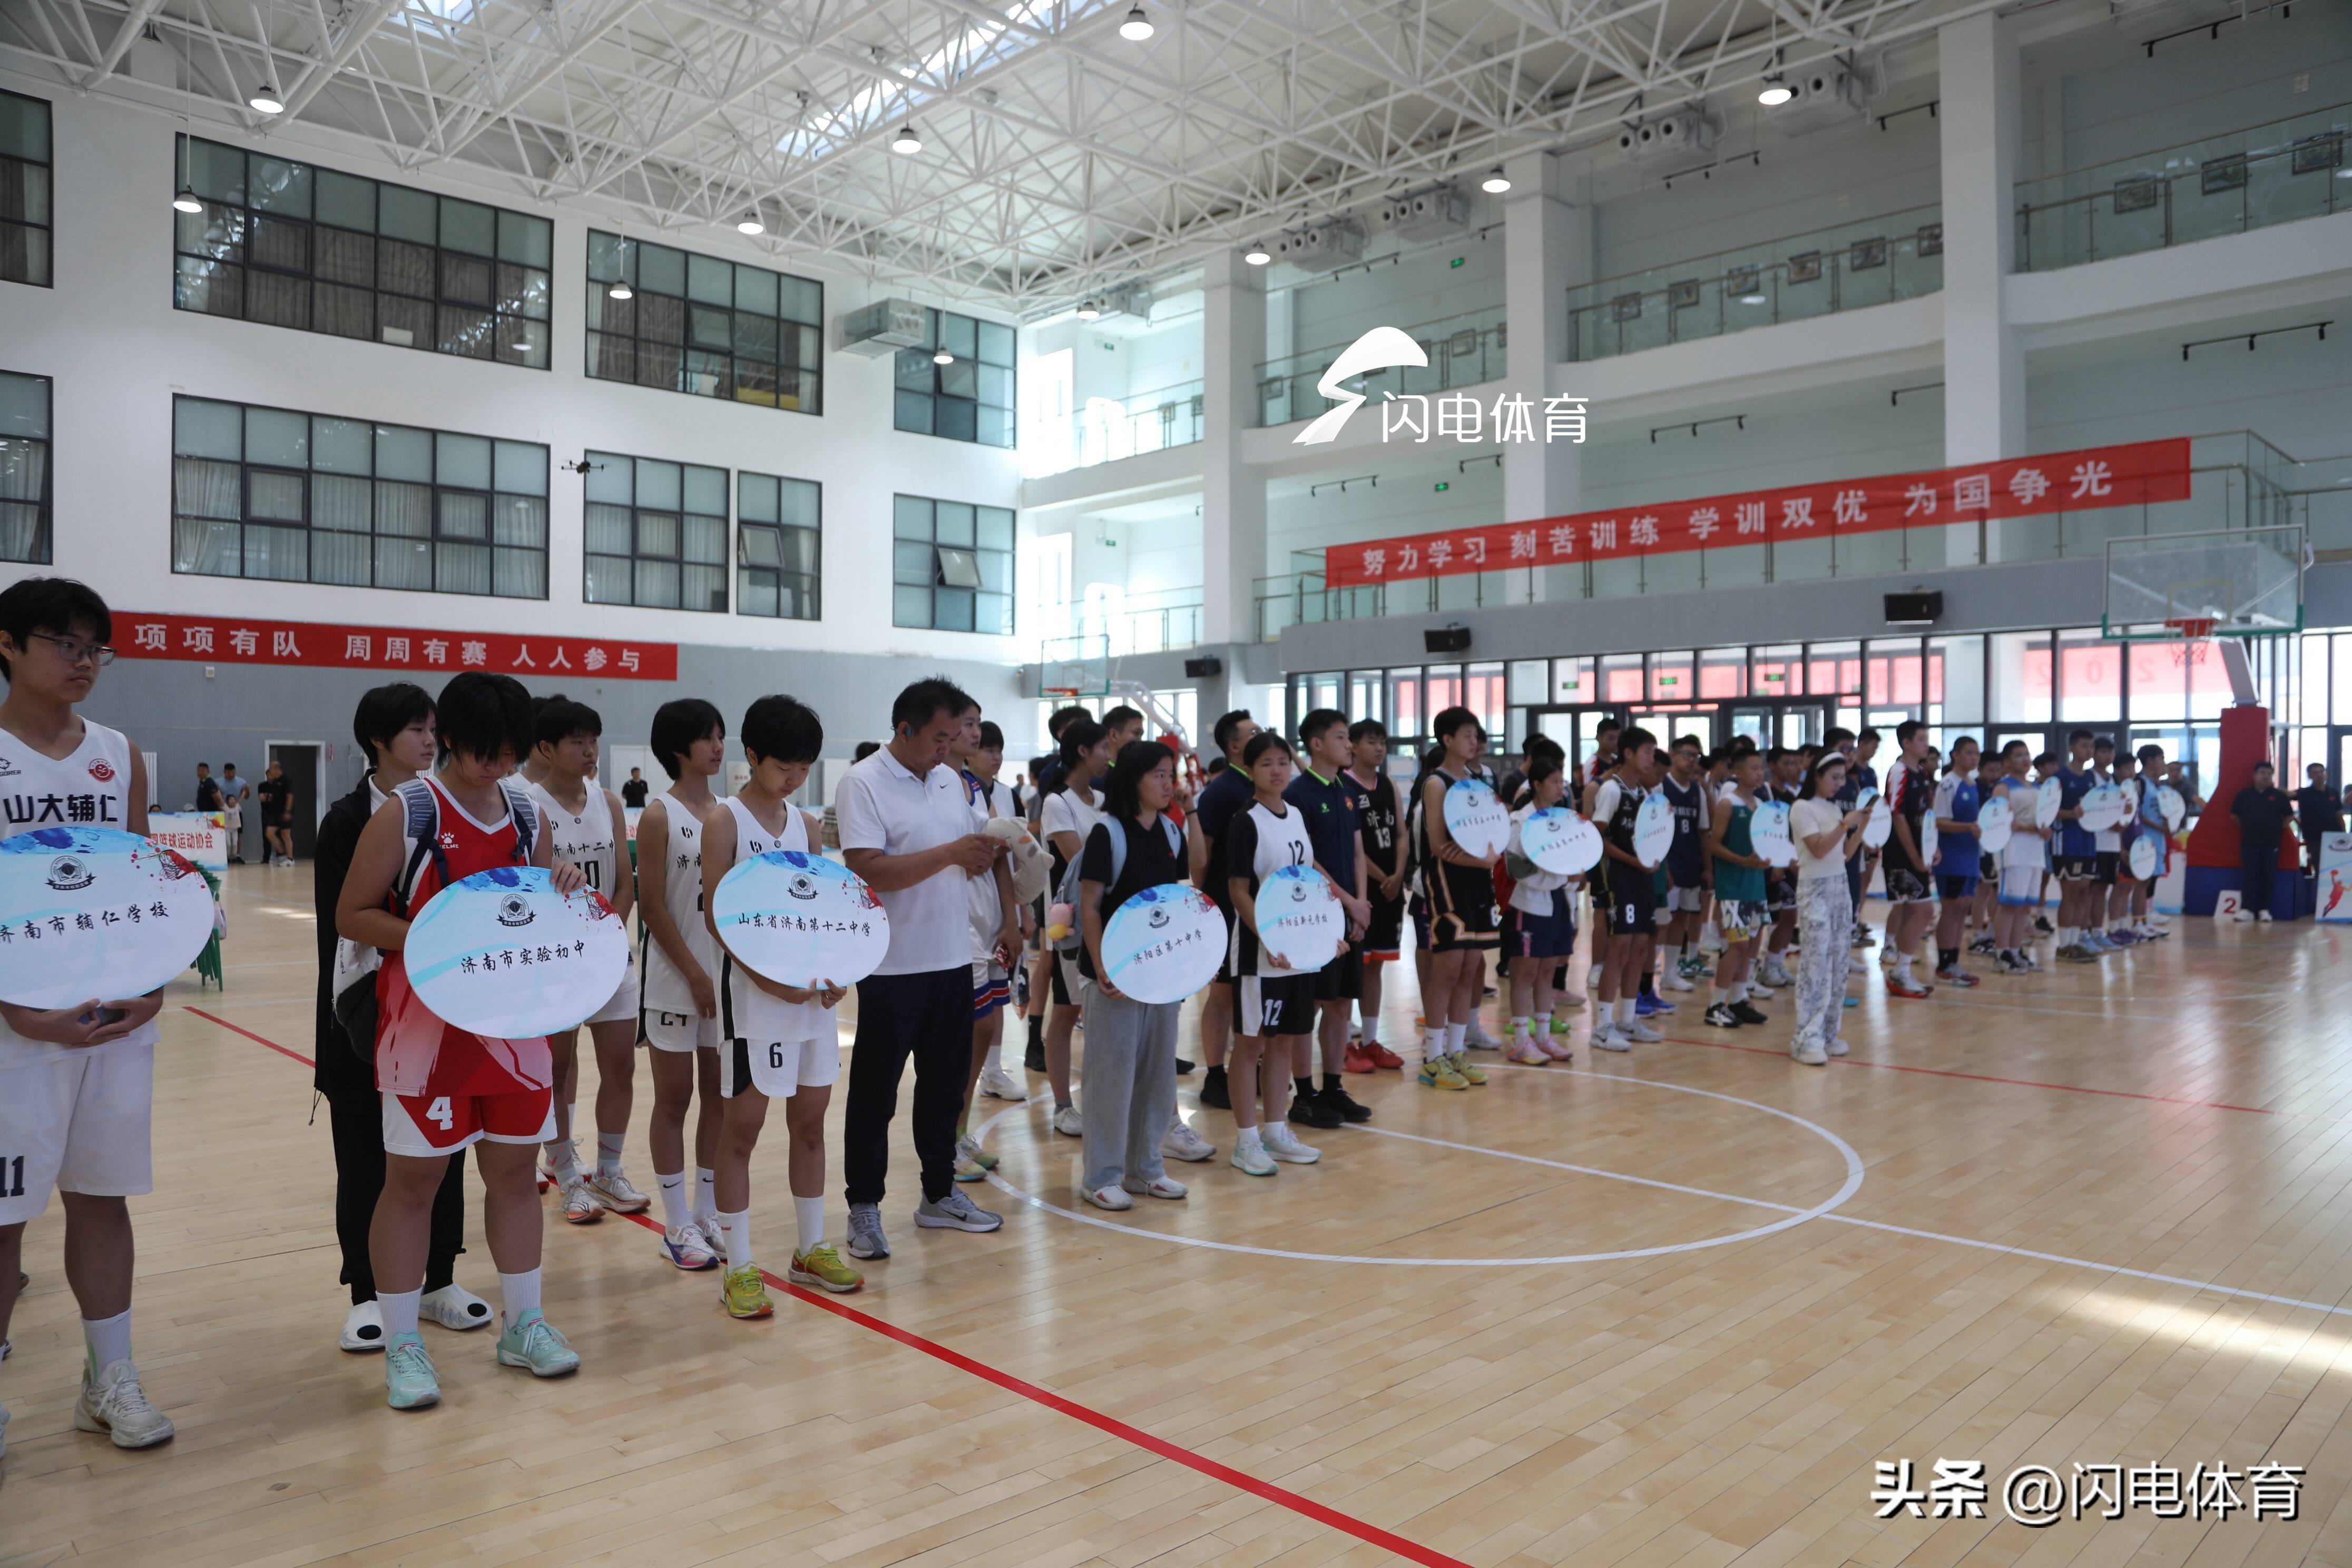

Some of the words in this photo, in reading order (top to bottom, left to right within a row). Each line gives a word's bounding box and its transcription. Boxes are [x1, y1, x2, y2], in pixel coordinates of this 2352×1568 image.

[1363, 537, 1486, 576] 努力学习
[1511, 515, 1660, 560] 刻苦训练
[1689, 489, 1868, 540] 学训双优
[1905, 461, 2113, 517] 为国争光
[135, 623, 302, 658] 项项有队
[345, 635, 487, 665] 周周有赛
[512, 643, 640, 672] 人人参与
[3, 793, 118, 824] 山大辅仁
[1375, 827, 1391, 849] 13
[1288, 840, 1305, 866] 12
[1626, 904, 1635, 924] 8
[2224, 897, 2237, 914] 2
[0, 901, 170, 944] 济南市辅仁学校
[738, 913, 871, 936] 山东省济南第十二中学
[461, 939, 584, 974] 济南市实验初中
[1134, 928, 1202, 965] 济阳区第十中学
[1265, 999, 1282, 1026] 12
[769, 1042, 783, 1069] 6
[426, 1096, 453, 1130] 4
